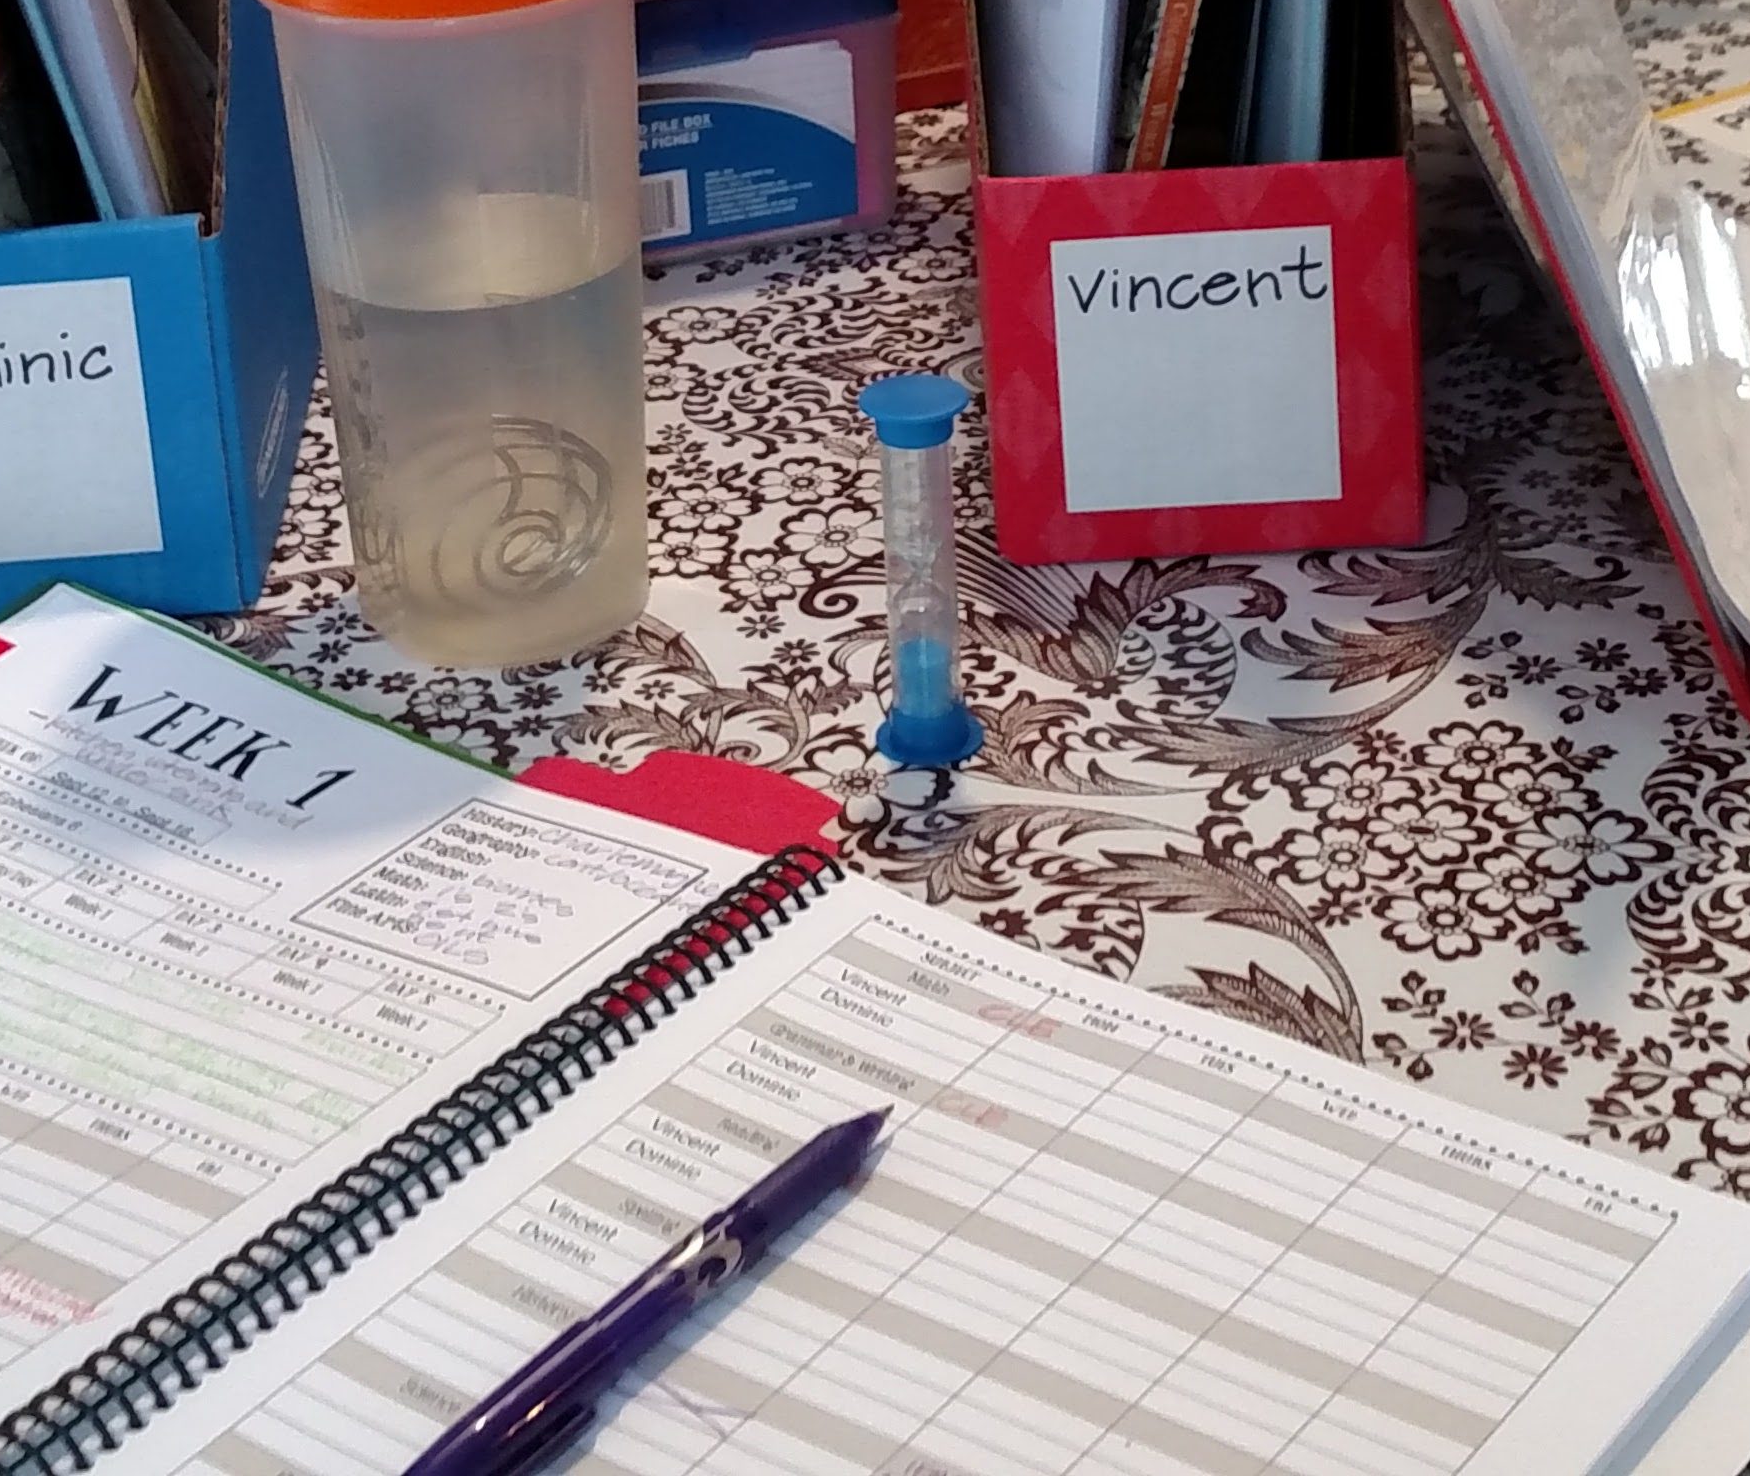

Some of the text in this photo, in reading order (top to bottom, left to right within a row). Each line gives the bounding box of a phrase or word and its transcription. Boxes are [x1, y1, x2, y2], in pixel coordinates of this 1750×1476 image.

[651, 118, 679, 133] FILE
[683, 112, 713, 128] BOX
[651, 130, 700, 150] FICHES
[1068, 245, 1328, 314] Vincent
[68, 663, 357, 811] WEEK 1
[818, 984, 895, 1029] Dominic
[840, 967, 908, 1008] Vincent
[725, 1058, 802, 1103] Dominic
[748, 1037, 818, 1080] Vincent
[625, 1136, 703, 1182] Dominic
[651, 1115, 722, 1159] Vincent
[518, 1219, 597, 1266] Dominic
[548, 1197, 619, 1243] Vincent
